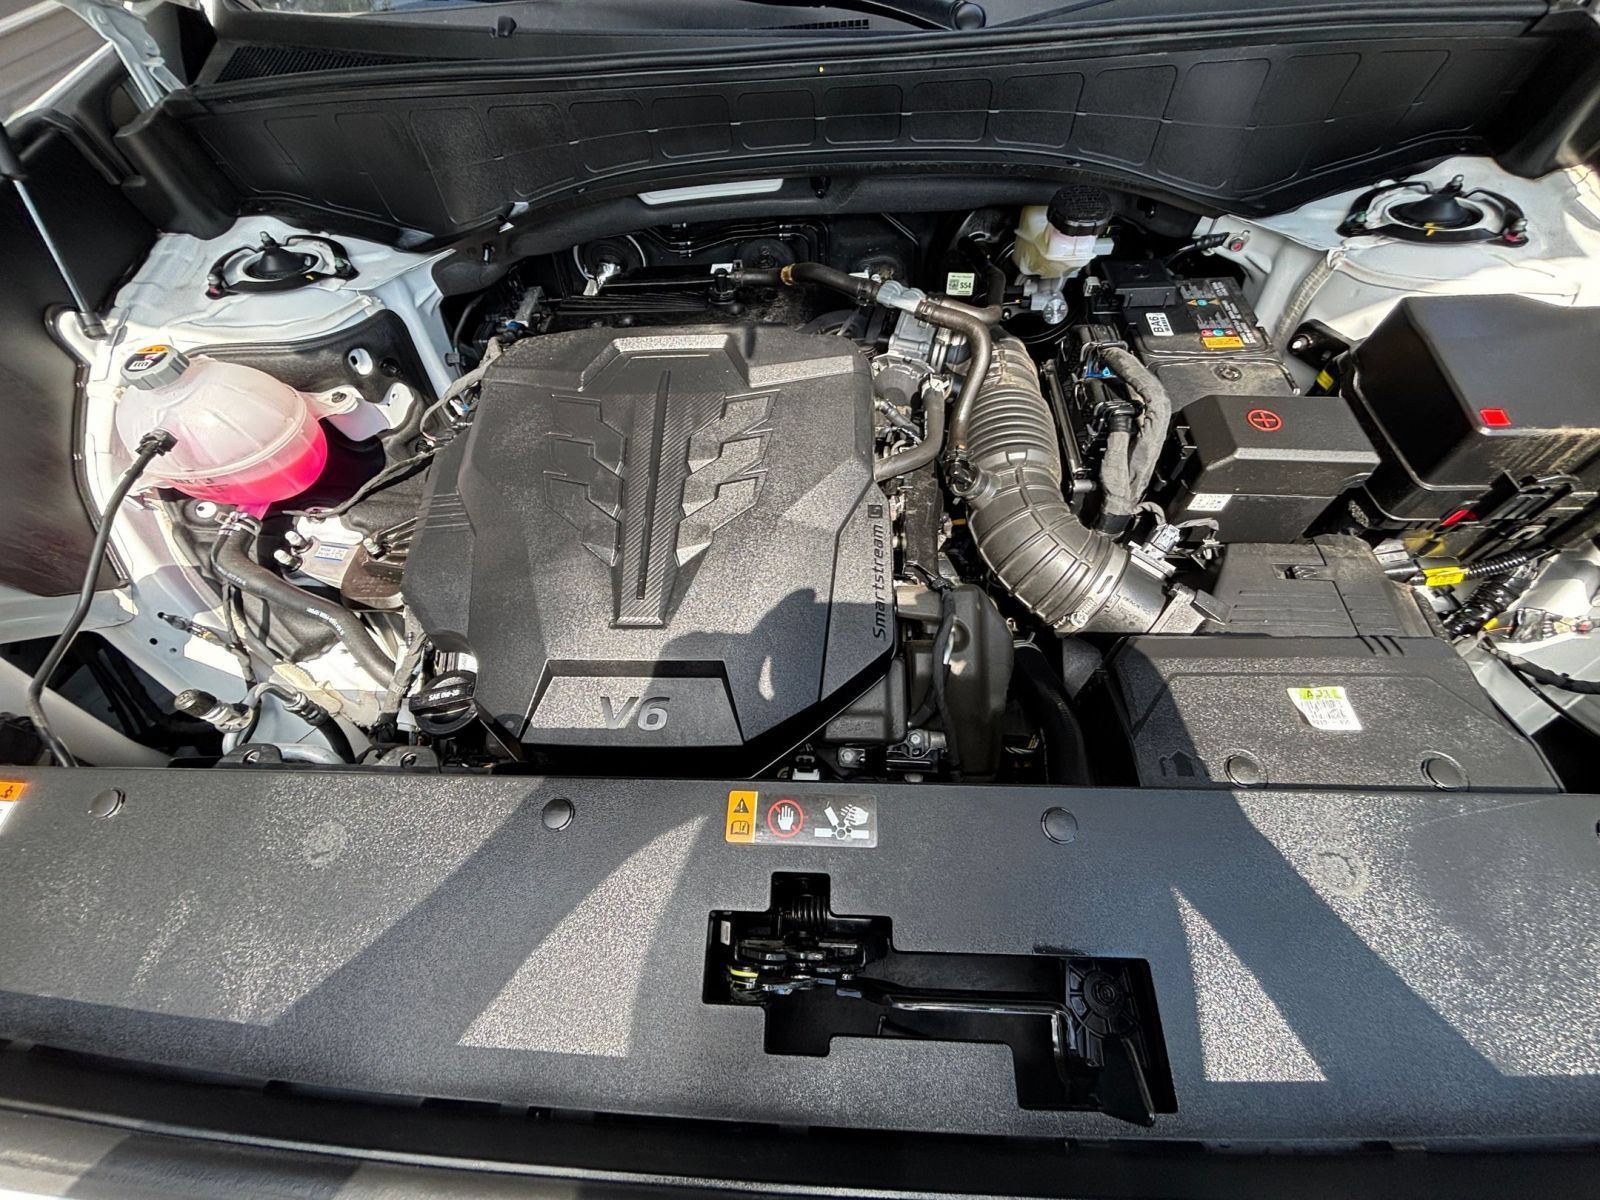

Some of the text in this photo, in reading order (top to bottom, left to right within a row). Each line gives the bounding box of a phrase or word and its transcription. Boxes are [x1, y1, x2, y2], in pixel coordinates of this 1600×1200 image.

[1149, 315, 1165, 333] BA6
[872, 524, 886, 642] Smartstream
[600, 696, 671, 731] V6
